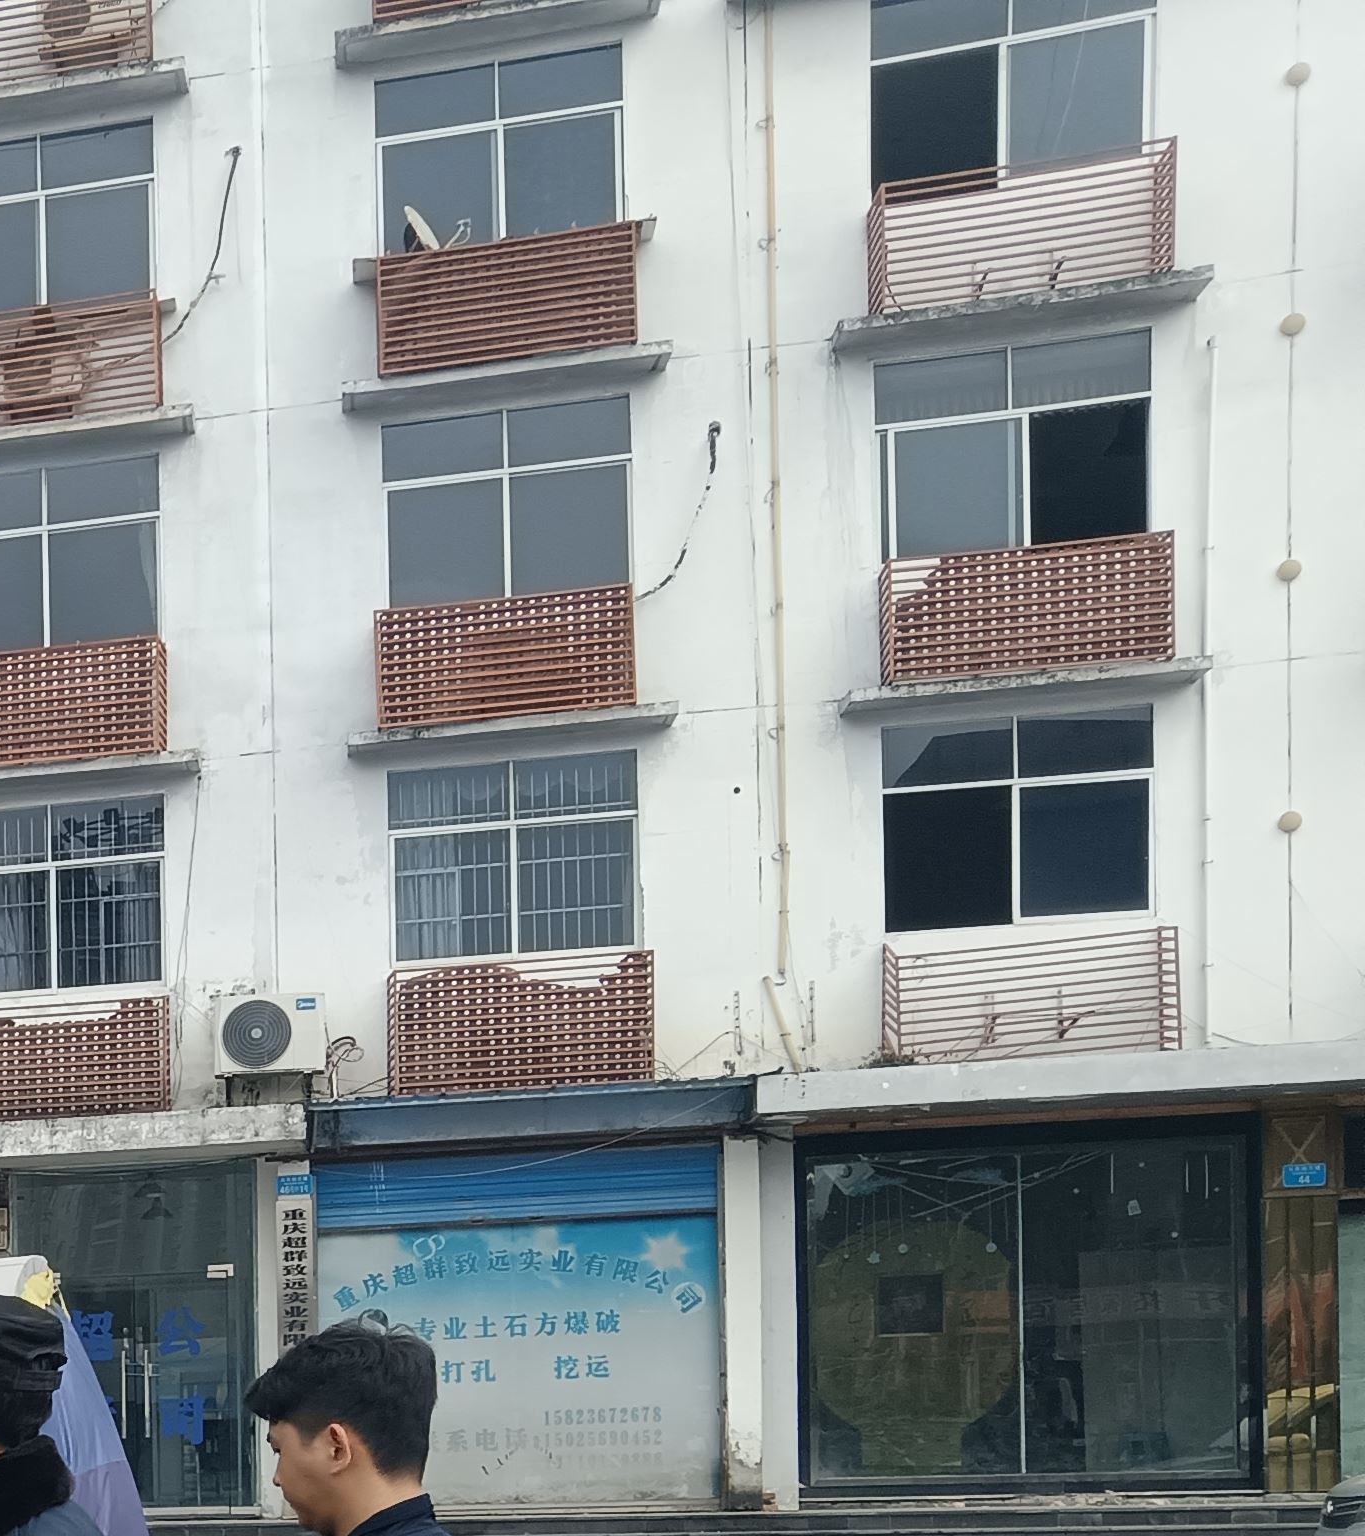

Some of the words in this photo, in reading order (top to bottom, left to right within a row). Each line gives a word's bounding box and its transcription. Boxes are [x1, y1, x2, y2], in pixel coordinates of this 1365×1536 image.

[333, 1249, 704, 1315] 重庆超群致远实业有限公司
[413, 1310, 622, 1341] 专业土石方爆破
[441, 1359, 497, 1384] 打孔
[554, 1354, 611, 1380] 挖运
[544, 1406, 663, 1427] 15823672678
